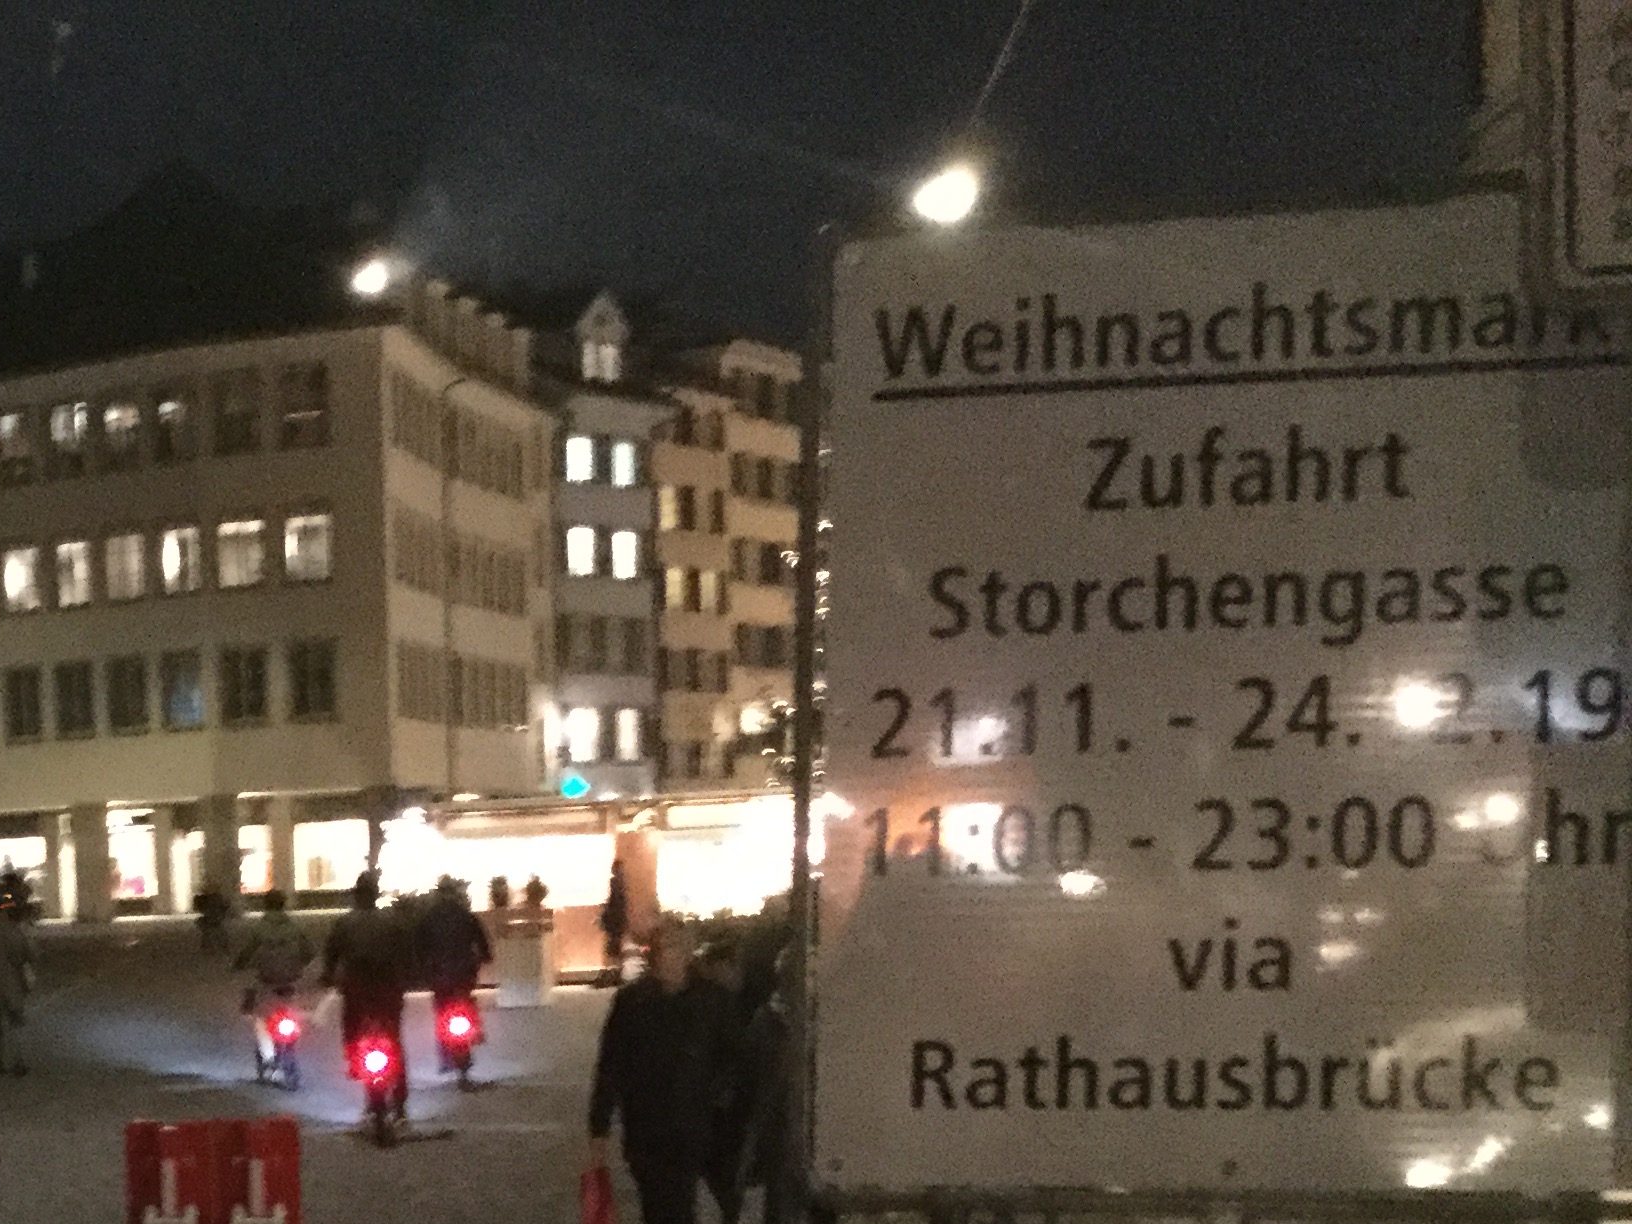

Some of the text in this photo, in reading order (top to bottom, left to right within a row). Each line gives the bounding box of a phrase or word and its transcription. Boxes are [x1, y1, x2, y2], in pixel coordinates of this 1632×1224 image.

[1084, 424, 1412, 512] Zufahrt
[927, 554, 1568, 647] Storchengasse
[869, 680, 1133, 760] 21.11.
[864, 801, 1094, 877] 11:00
[1190, 795, 1436, 872] 23:00
[1478, 787, 1632, 868] hr
[1168, 917, 1293, 992] via
[910, 1033, 1562, 1112] Rathausbrücke
